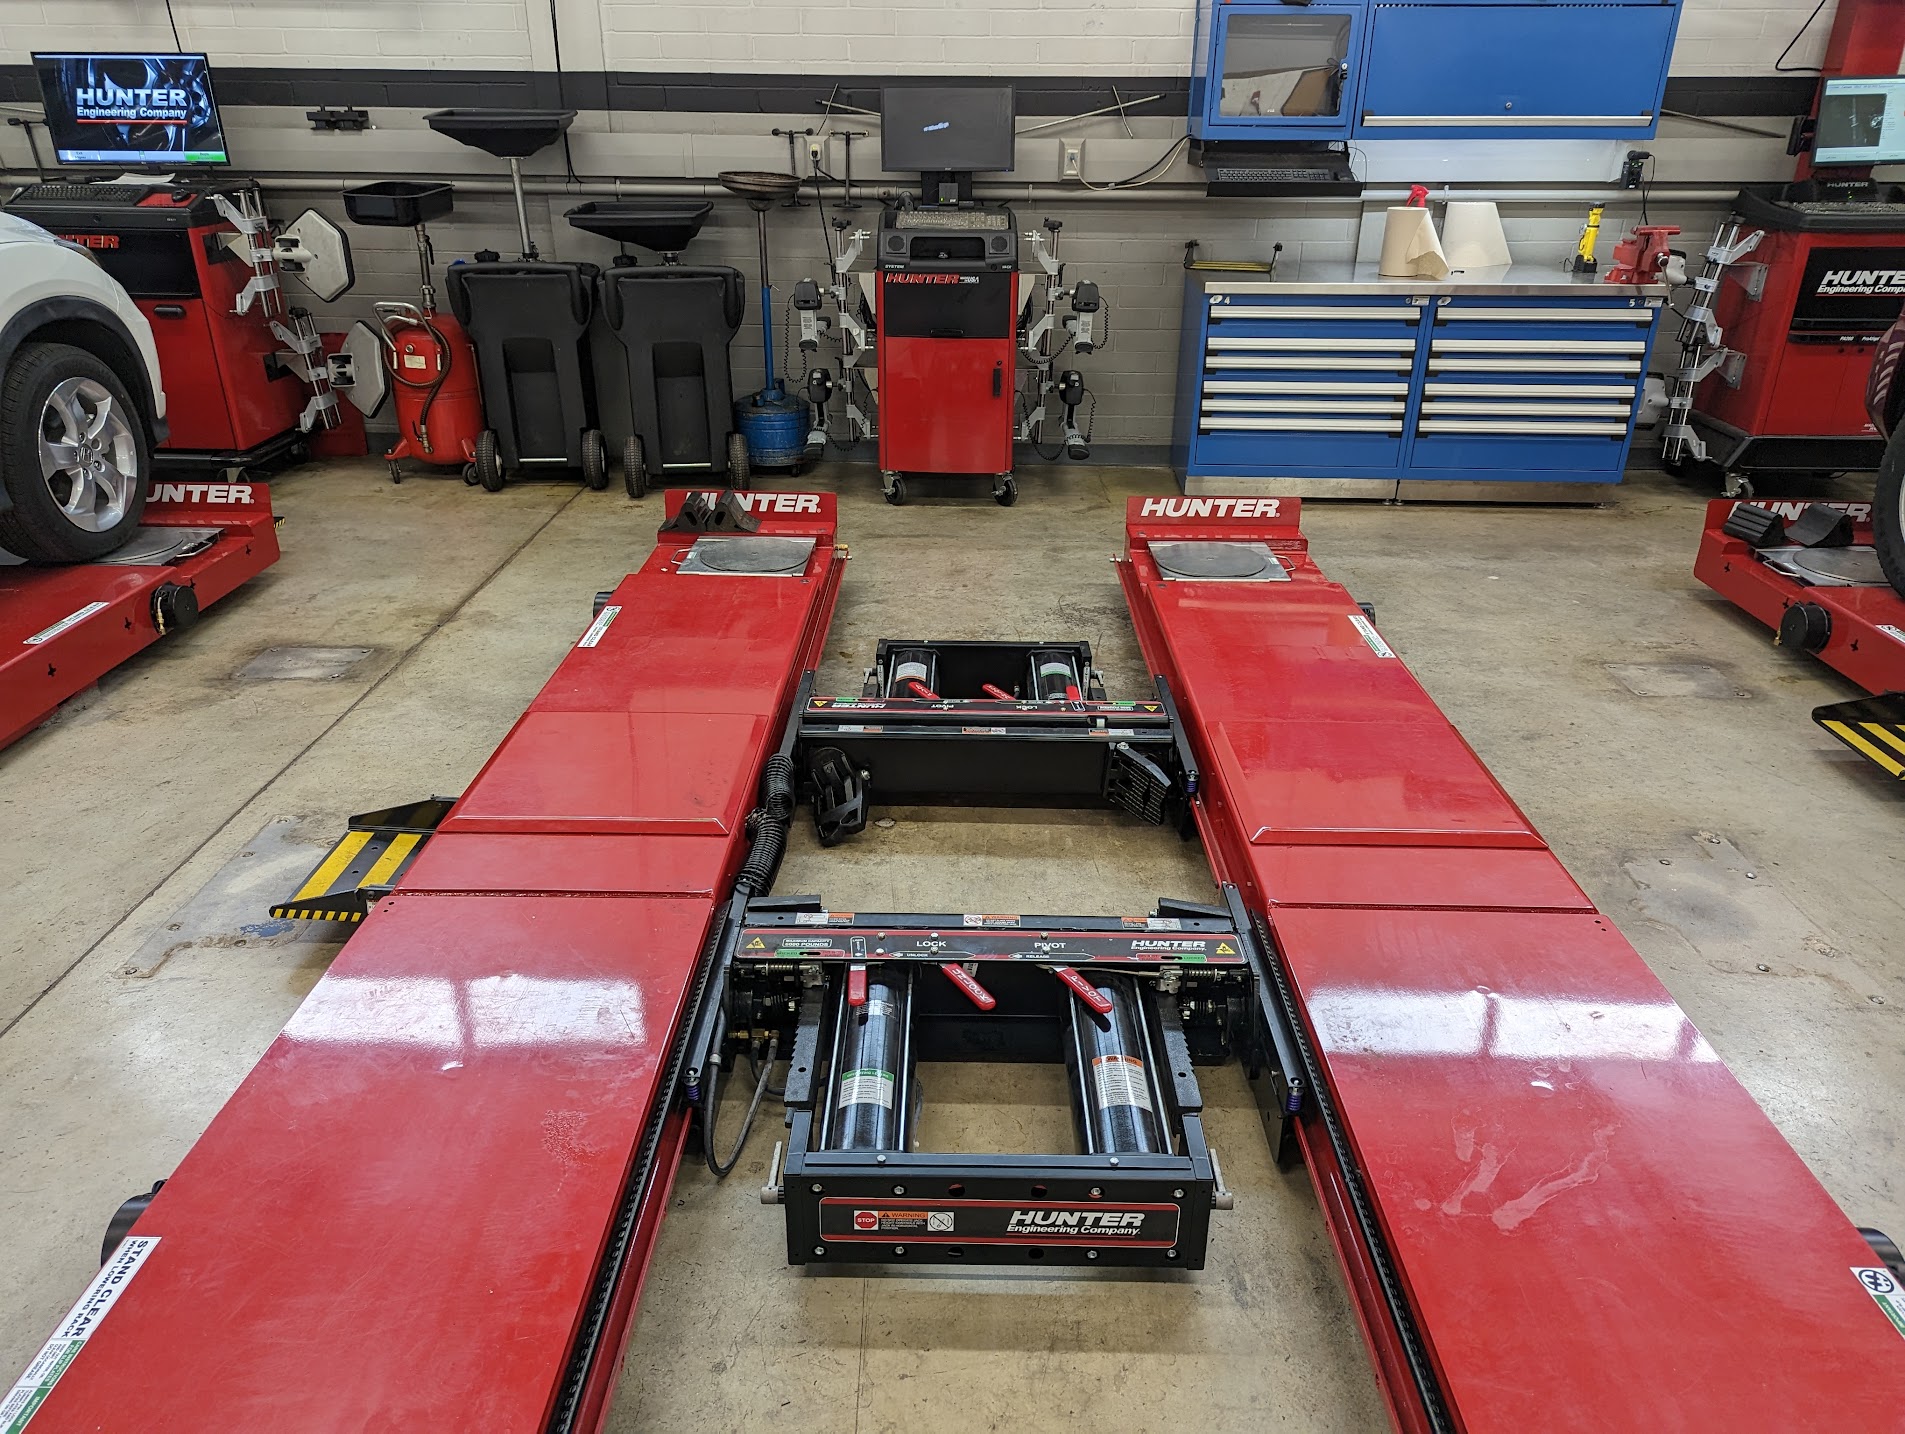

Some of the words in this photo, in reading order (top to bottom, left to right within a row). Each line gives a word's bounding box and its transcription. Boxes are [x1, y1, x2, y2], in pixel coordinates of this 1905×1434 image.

[76, 88, 188, 107] HUNTER
[76, 107, 136, 119] Engineering
[140, 108, 187, 119] Company
[885, 272, 960, 284] HUNTER
[1816, 284, 1874, 294] Engineering
[1224, 296, 1230, 304] 4
[1628, 298, 1636, 308] 5
[1140, 498, 1280, 518] HUNTER
[1071, 975, 1102, 1002] PIVOT
[1010, 1210, 1145, 1226] HUNTER
[1006, 1224, 1078, 1234] Engineering
[117, 1240, 138, 1263] WHEN
[111, 1240, 148, 1285] STAND
[82, 1266, 119, 1310] LOWERING
[72, 1289, 112, 1337] CLEAR
[62, 1313, 83, 1337] RACK
[14, 1396, 41, 1426] IMPORTANT
